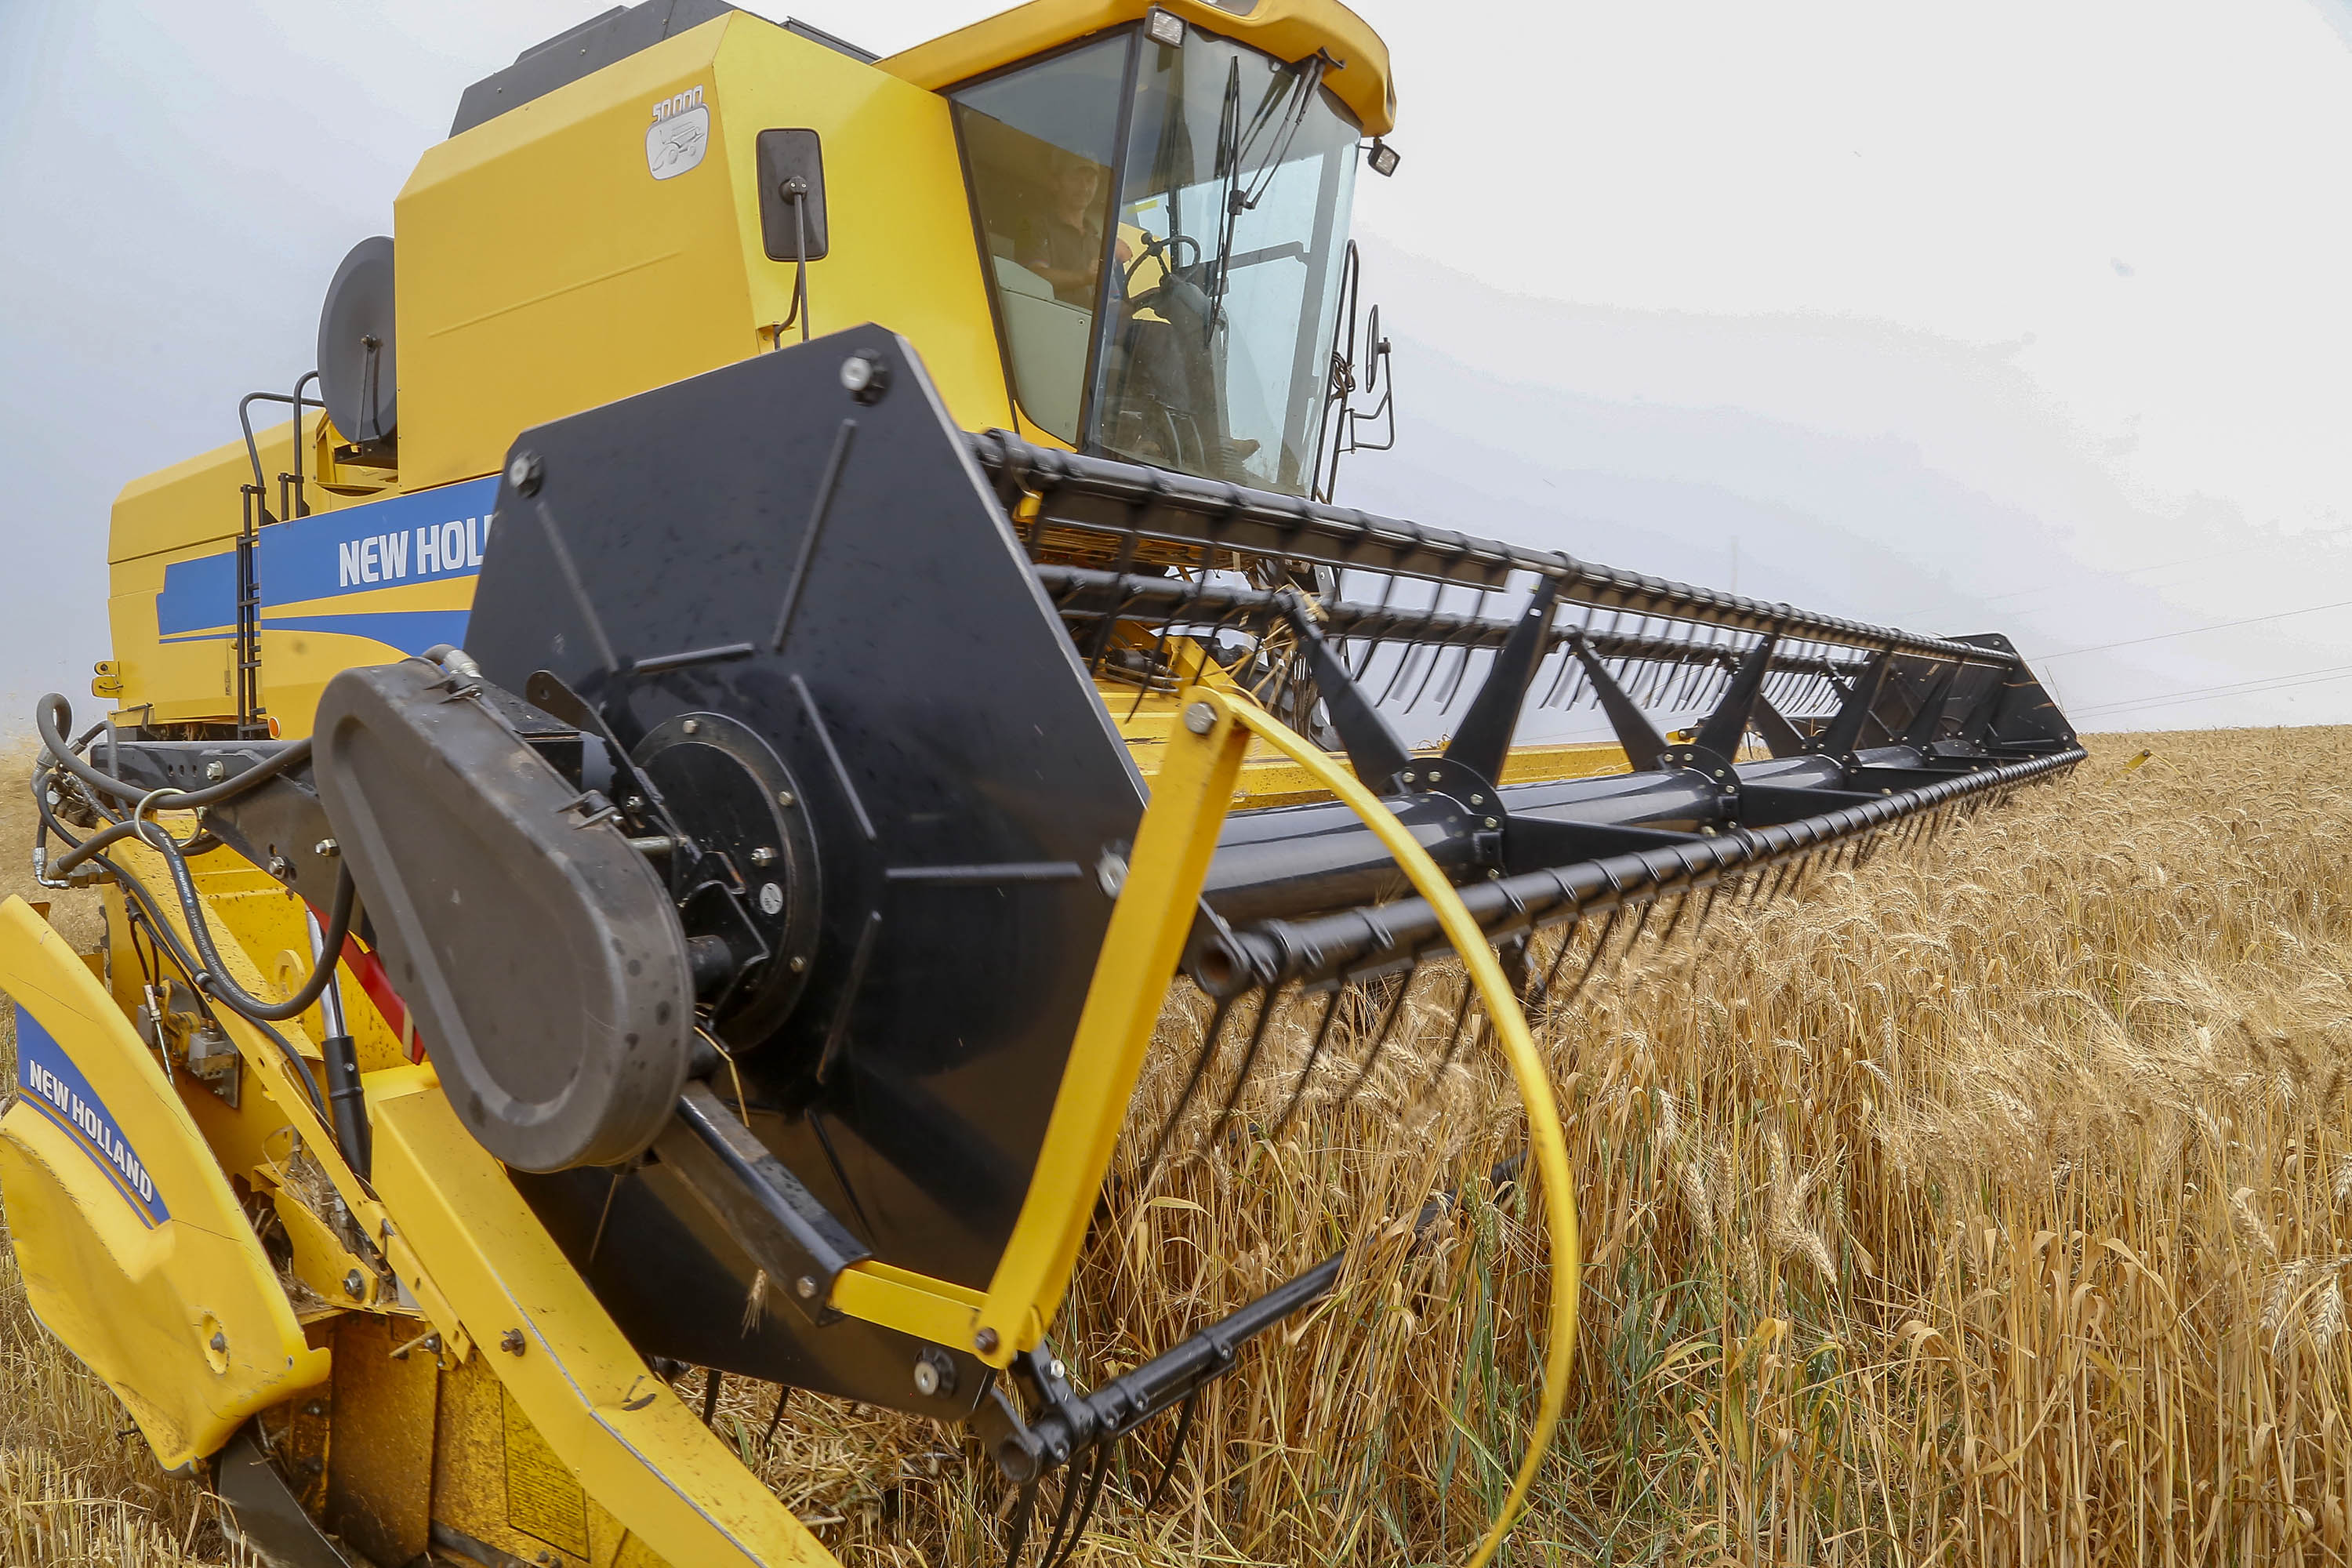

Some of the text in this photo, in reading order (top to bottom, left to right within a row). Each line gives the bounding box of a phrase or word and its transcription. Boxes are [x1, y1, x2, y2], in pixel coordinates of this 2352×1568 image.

[339, 530, 409, 587] NEW
[30, 1059, 153, 1203] NEW HOLLAND
